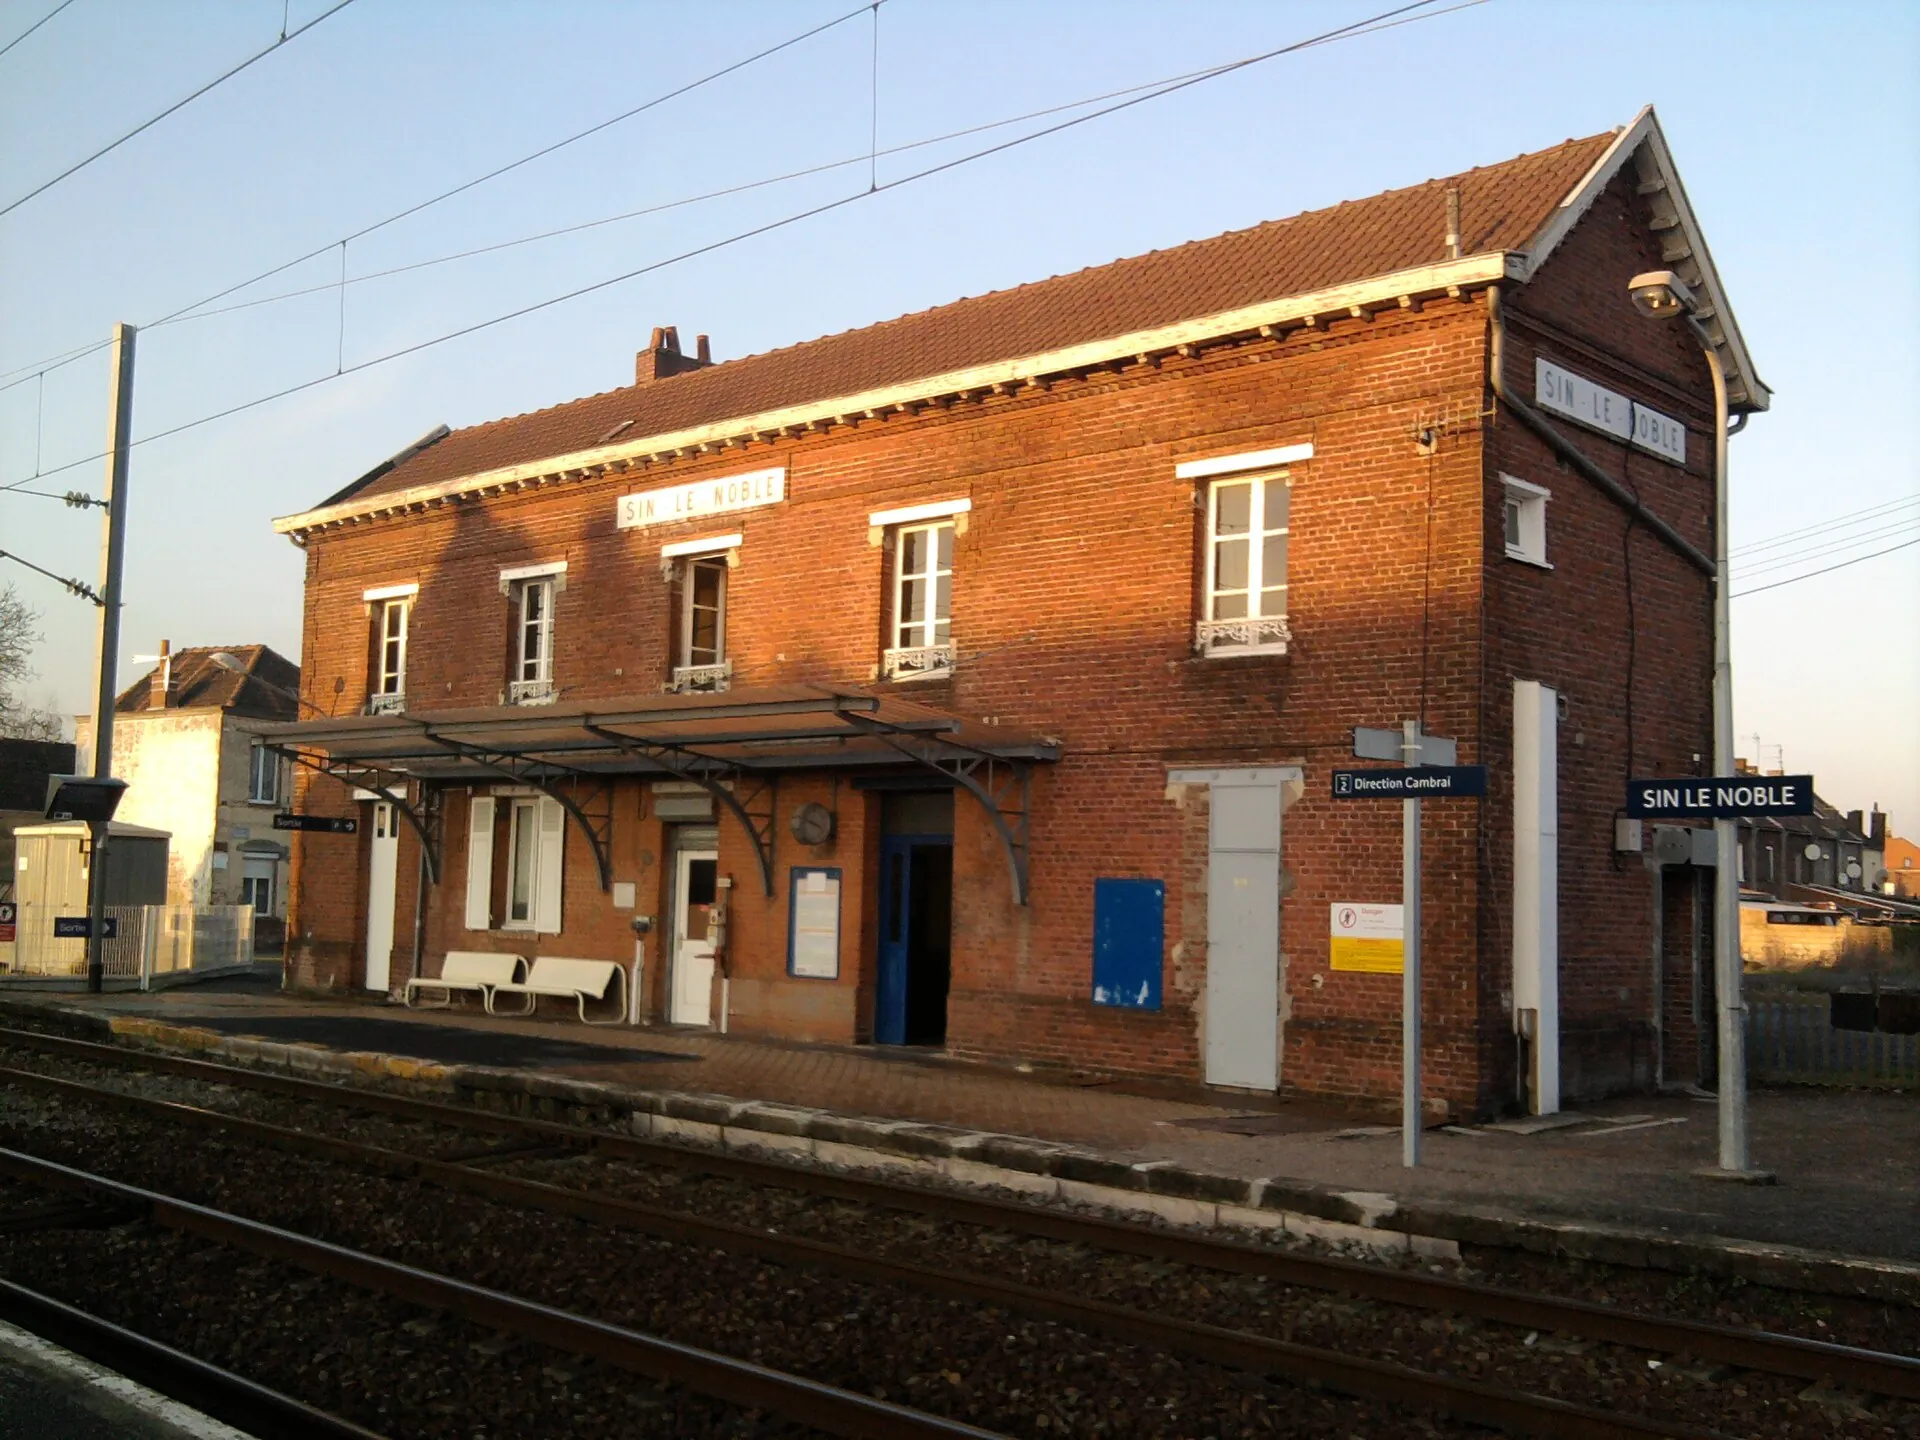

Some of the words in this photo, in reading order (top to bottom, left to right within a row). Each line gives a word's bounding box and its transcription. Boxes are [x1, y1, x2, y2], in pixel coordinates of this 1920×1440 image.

[1545, 370, 1574, 408] SIN
[1593, 392, 1611, 424] LE
[626, 499, 655, 520] SIN
[675, 491, 695, 512] LE
[714, 476, 775, 506] NOBLE
[1340, 781, 1348, 792] 2
[1354, 777, 1403, 790] Direction
[1405, 776, 1451, 789] Cambrai
[1642, 789, 1679, 808] SIN
[1685, 788, 1712, 807] LE
[1717, 786, 1796, 807] NOBLE
[60, 921, 86, 933] Sortie
